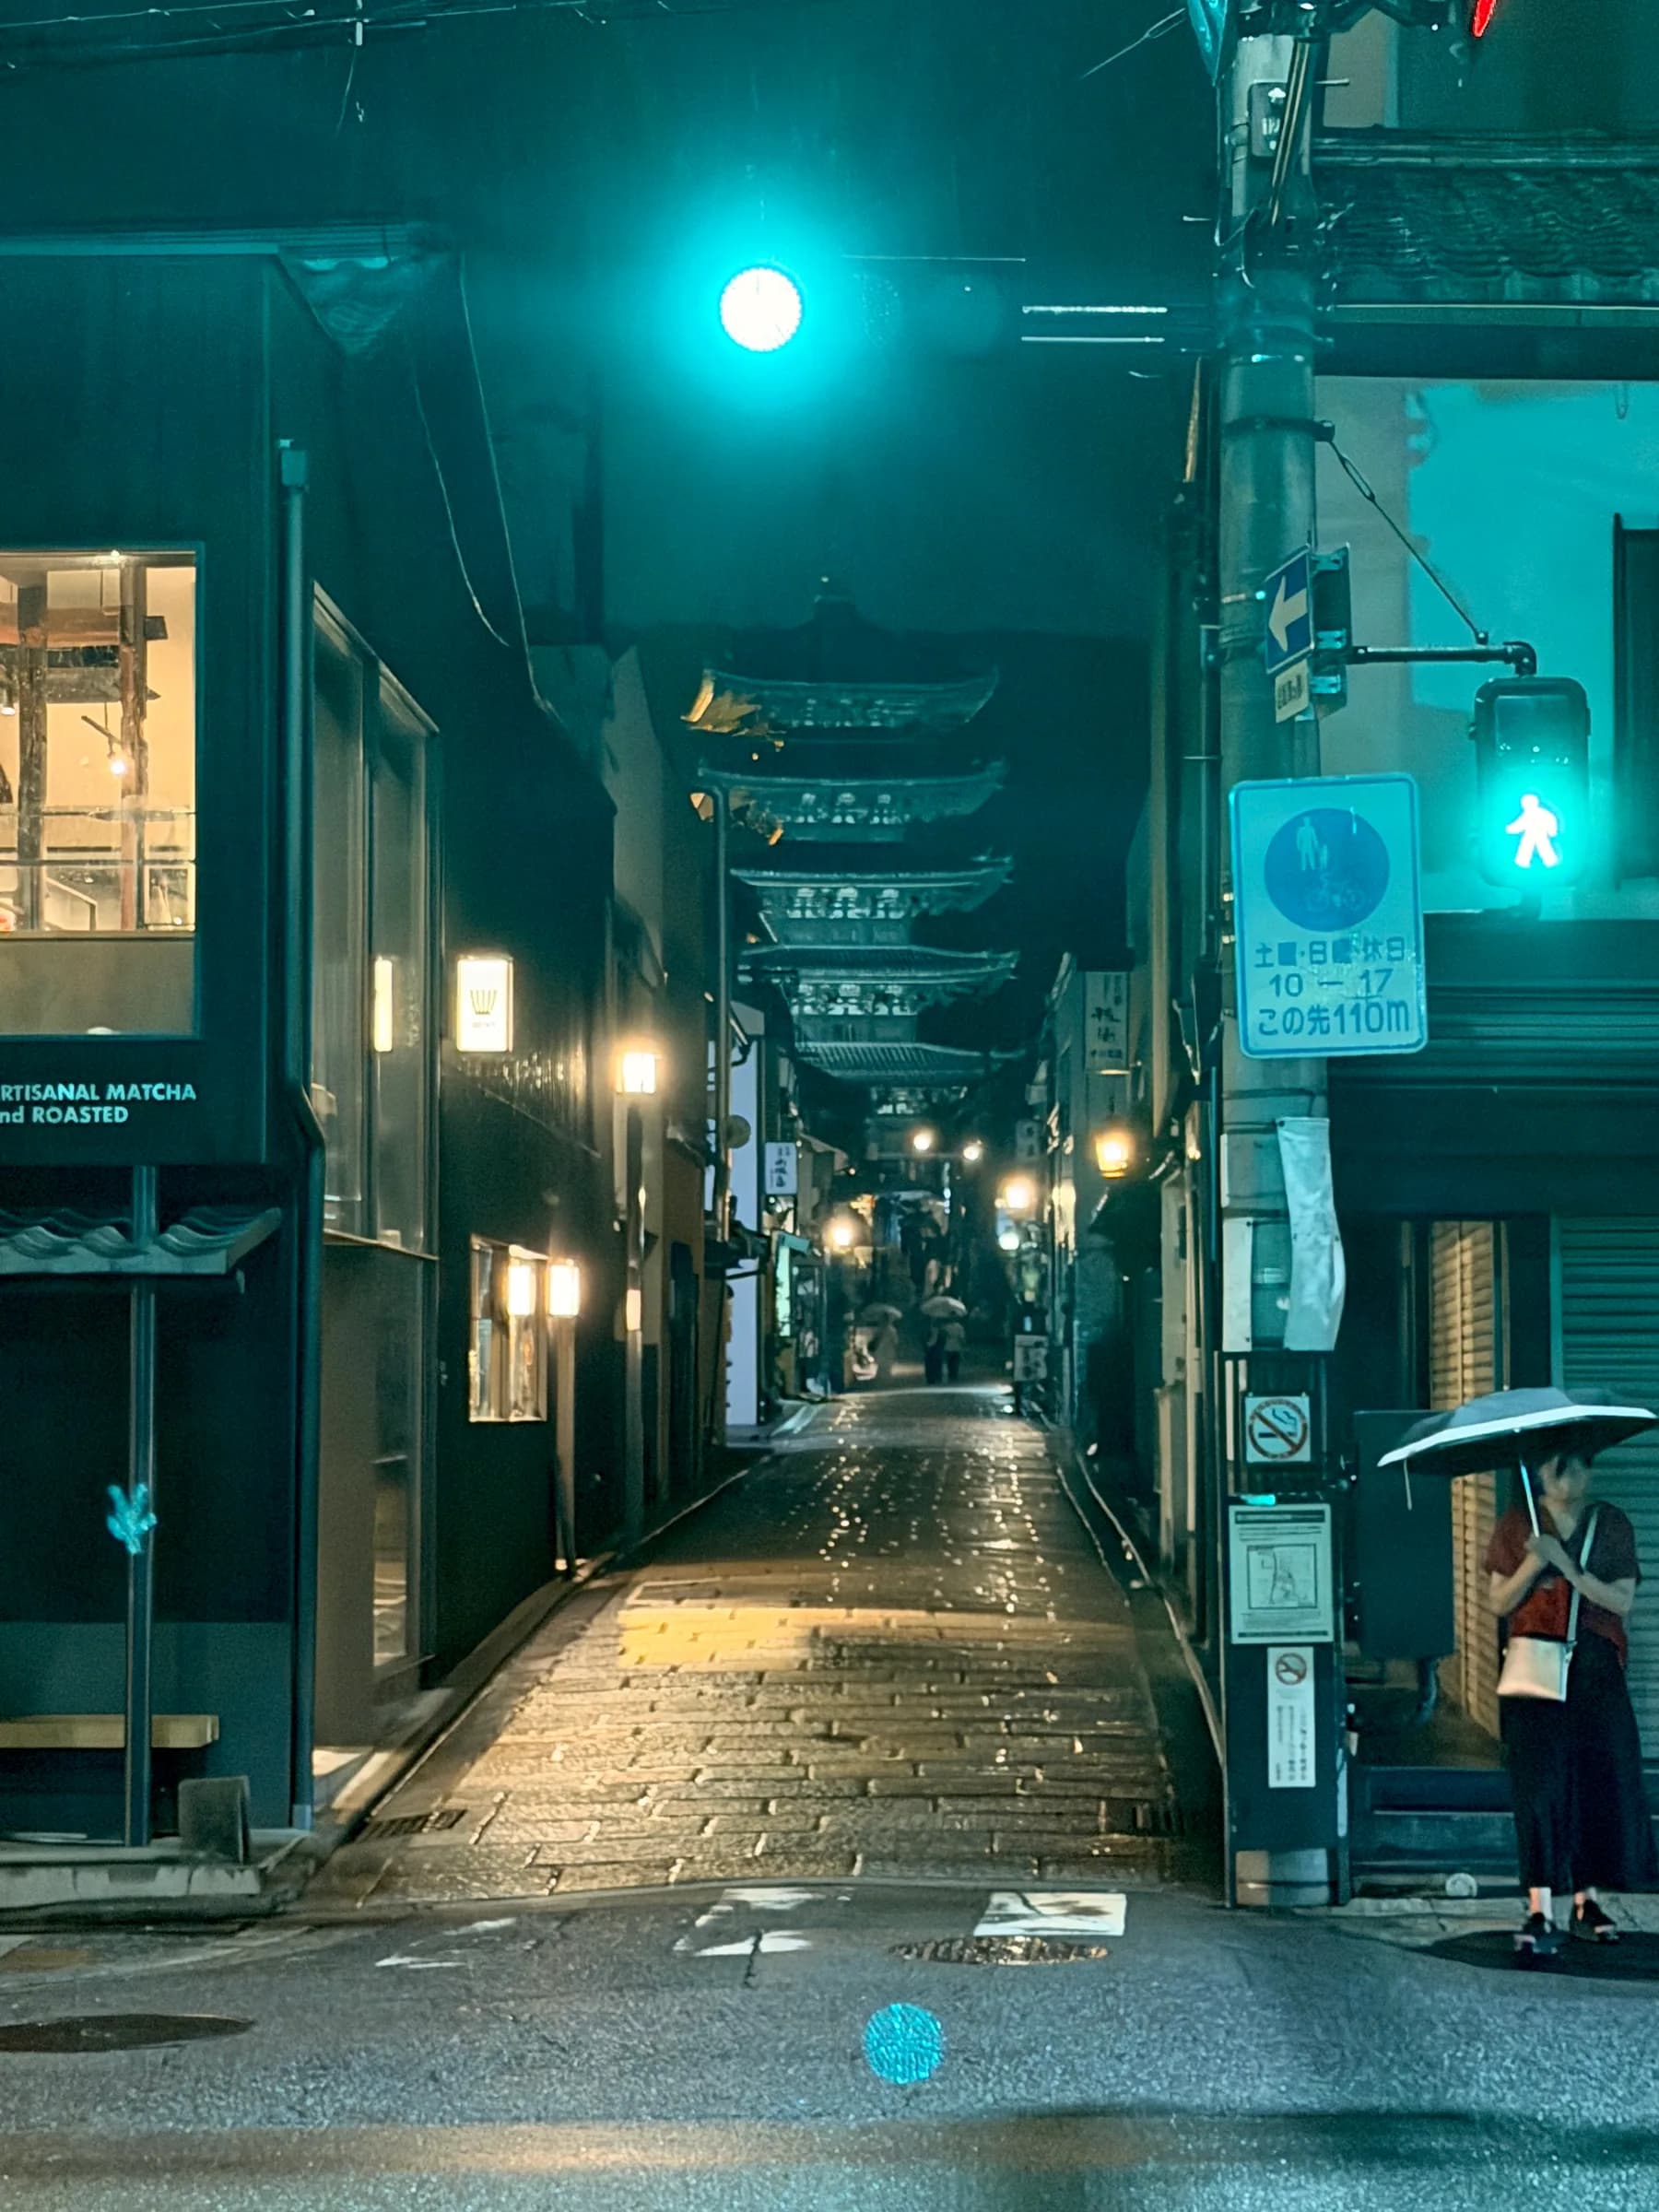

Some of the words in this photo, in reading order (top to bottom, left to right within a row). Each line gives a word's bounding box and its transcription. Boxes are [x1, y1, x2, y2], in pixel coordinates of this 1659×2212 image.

[1269, 973, 1303, 997] 10
[1359, 968, 1394, 994] 17
[1259, 1001, 1409, 1035] この先110m
[105, 1083, 196, 1100] MATCHA
[32, 1106, 129, 1124] ROASTED
